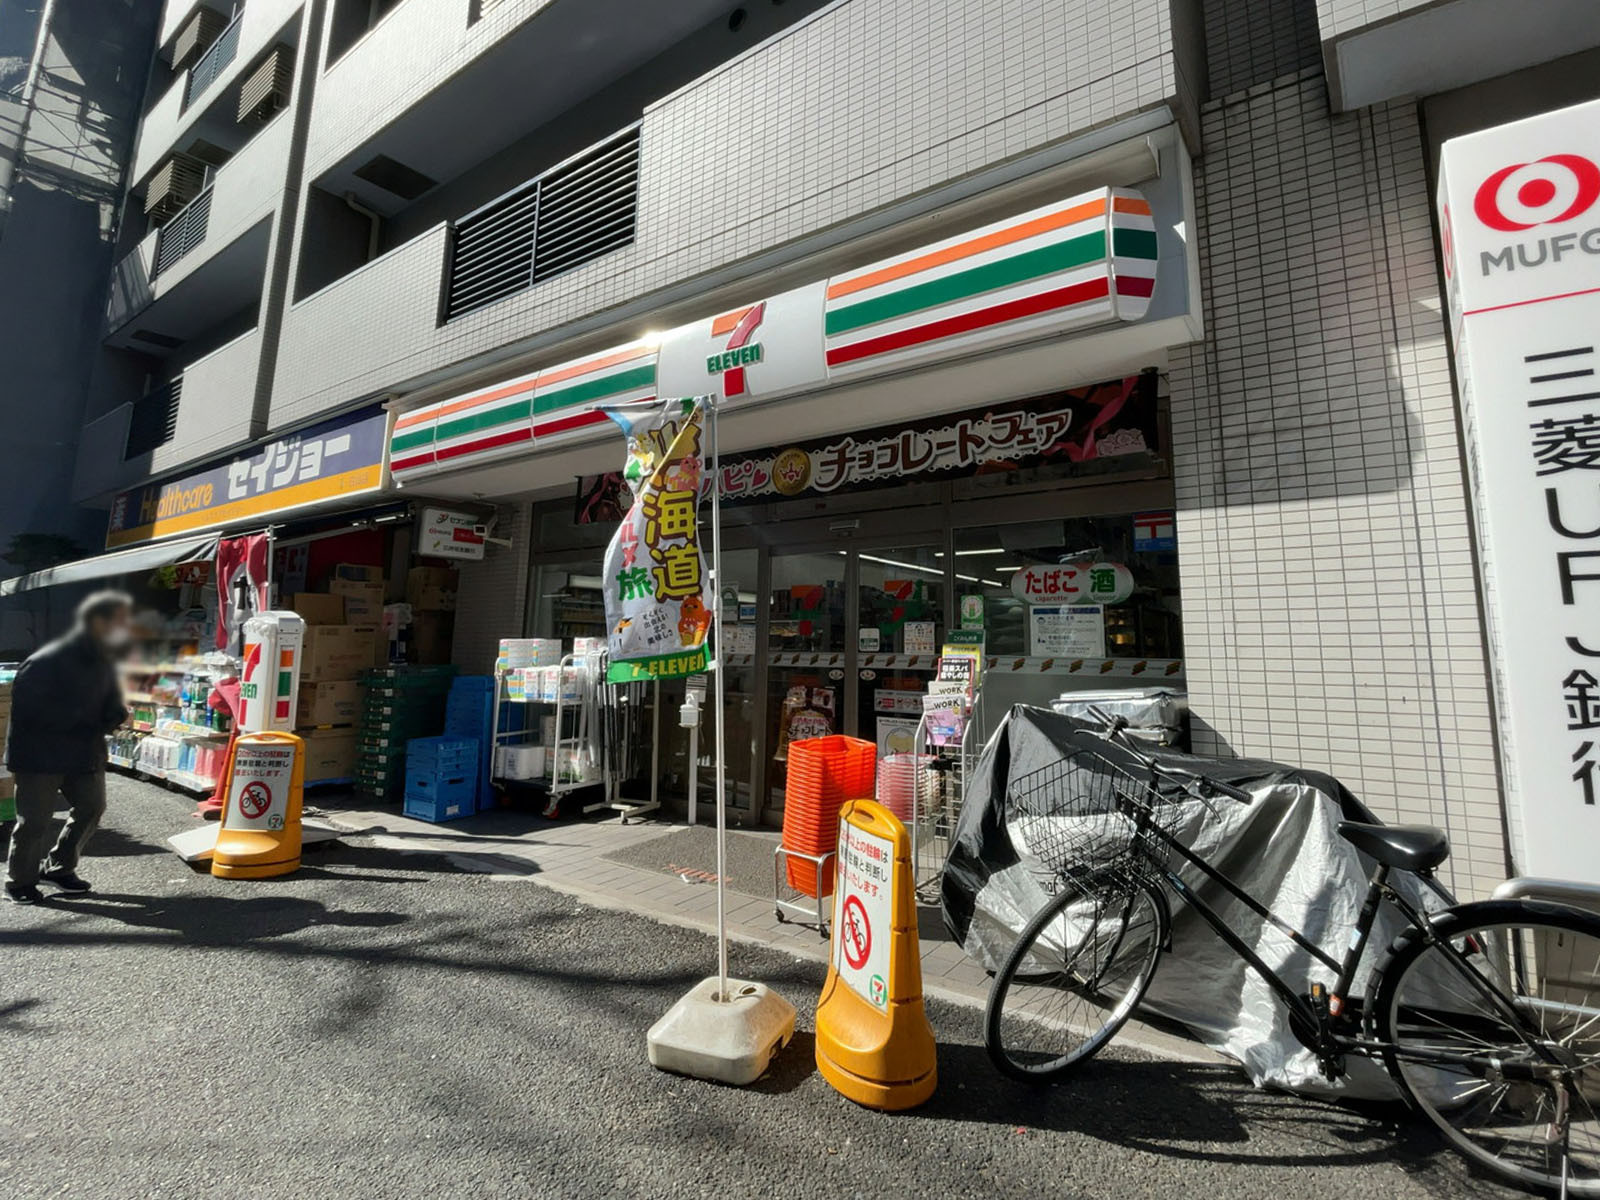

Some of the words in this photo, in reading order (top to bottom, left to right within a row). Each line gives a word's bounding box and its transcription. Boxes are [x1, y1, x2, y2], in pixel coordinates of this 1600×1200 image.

[1480, 229, 1600, 276] MUFG
[814, 410, 1070, 490] チョコレートフェア
[228, 434, 351, 500] セイジョー
[139, 482, 213, 524] Healthcare
[1025, 569, 1079, 594] たばこ
[1090, 568, 1116, 593] 酒
[933, 698, 960, 709] WORK
[939, 686, 963, 695] WORK
